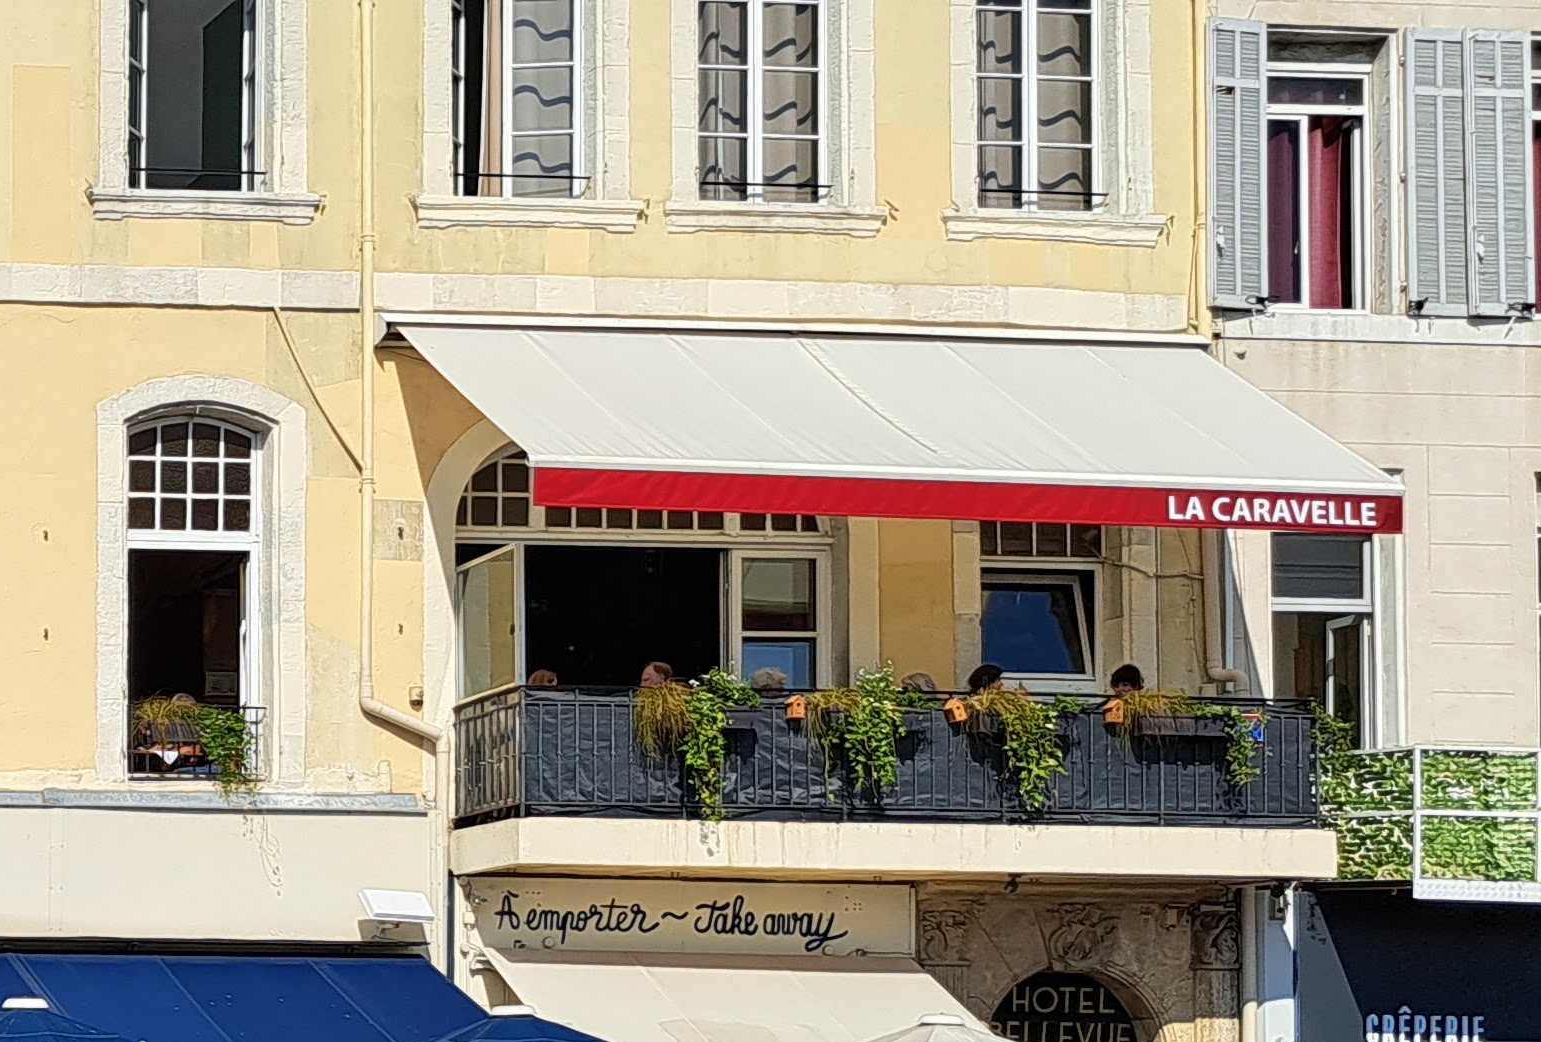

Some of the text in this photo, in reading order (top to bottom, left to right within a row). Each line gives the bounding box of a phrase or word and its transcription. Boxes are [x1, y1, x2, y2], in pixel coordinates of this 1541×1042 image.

[1168, 496, 1377, 527] LA CARAVELLE
[526, 898, 661, 945] emporter
[693, 895, 758, 936] Take
[762, 911, 849, 952] away
[1012, 986, 1116, 1015] HOTEL
